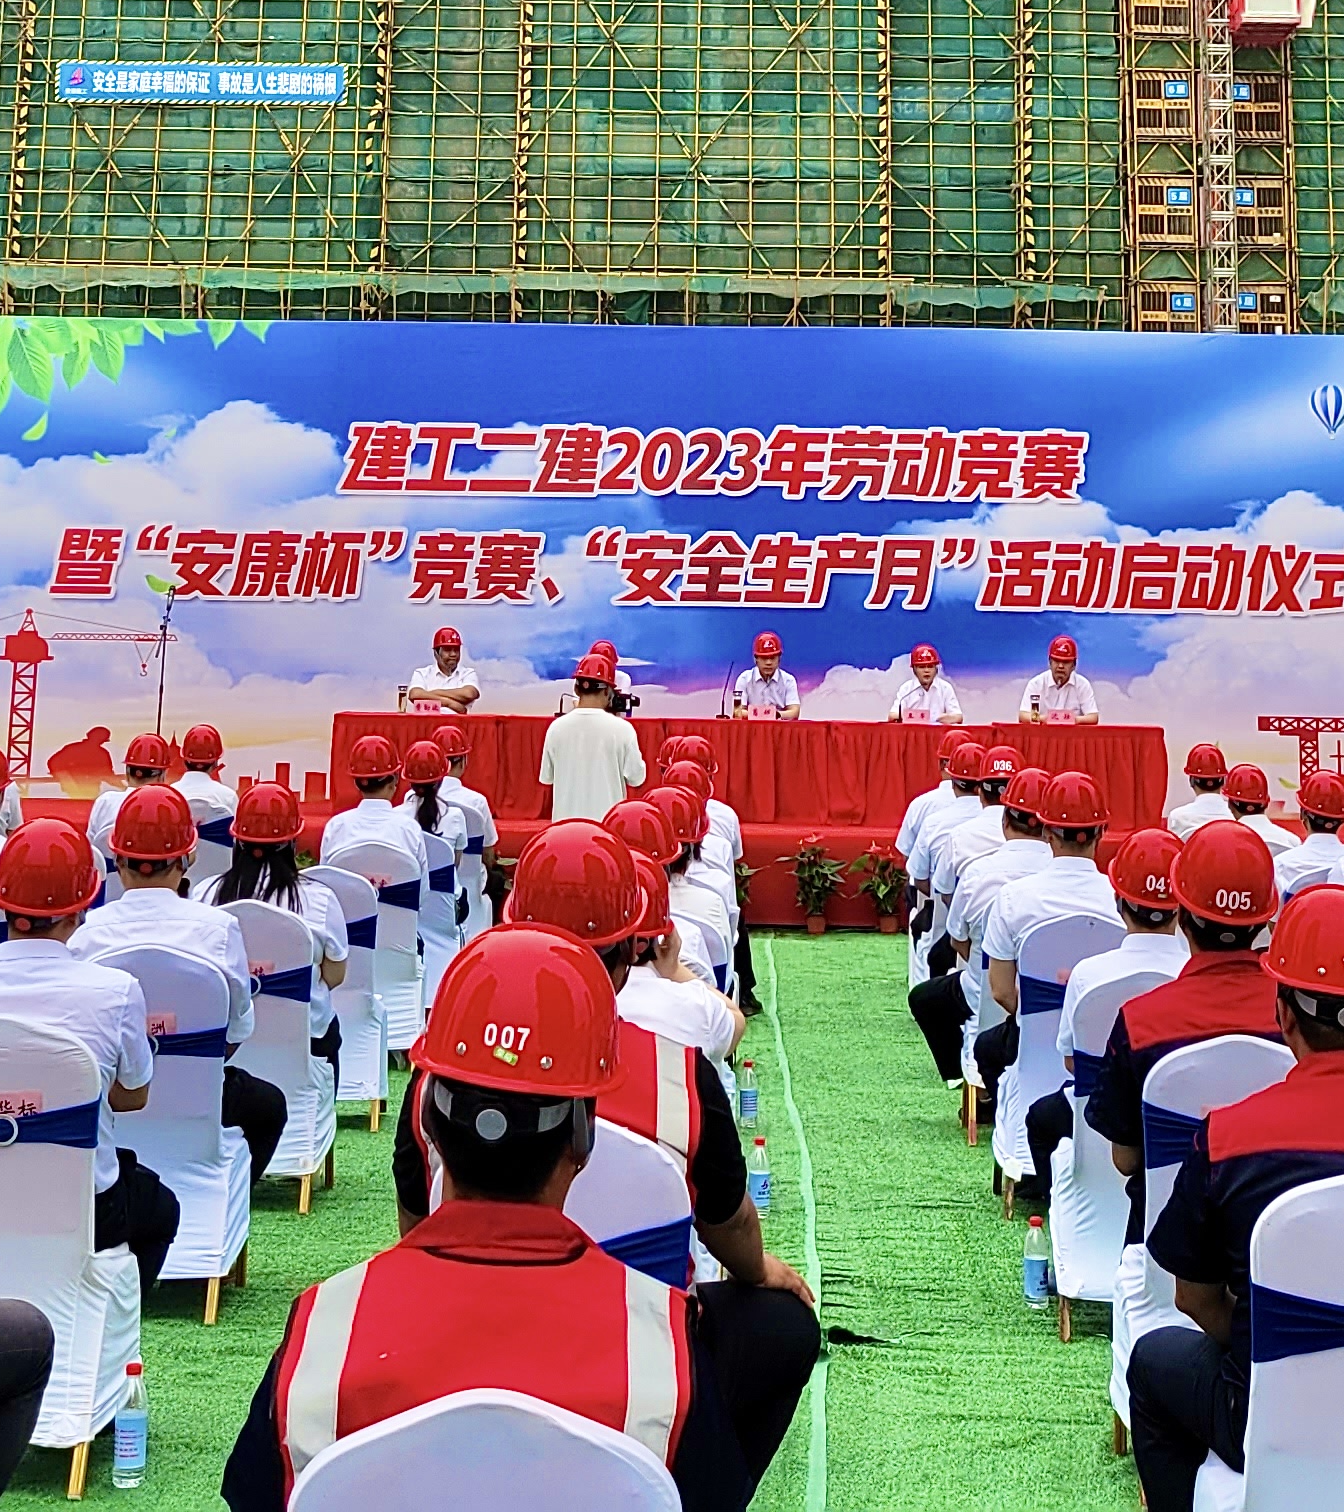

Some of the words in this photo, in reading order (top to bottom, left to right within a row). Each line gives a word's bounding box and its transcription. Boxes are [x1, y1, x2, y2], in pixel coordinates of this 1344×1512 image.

[92, 70, 210, 95] 安全是家庭幸福的保证
[218, 71, 336, 96] 事故是人生悲剧的祸根
[341, 423, 1086, 501] 建工二建2023年劳动竞赛
[1216, 889, 1251, 910] 005
[484, 1023, 530, 1051] 007
